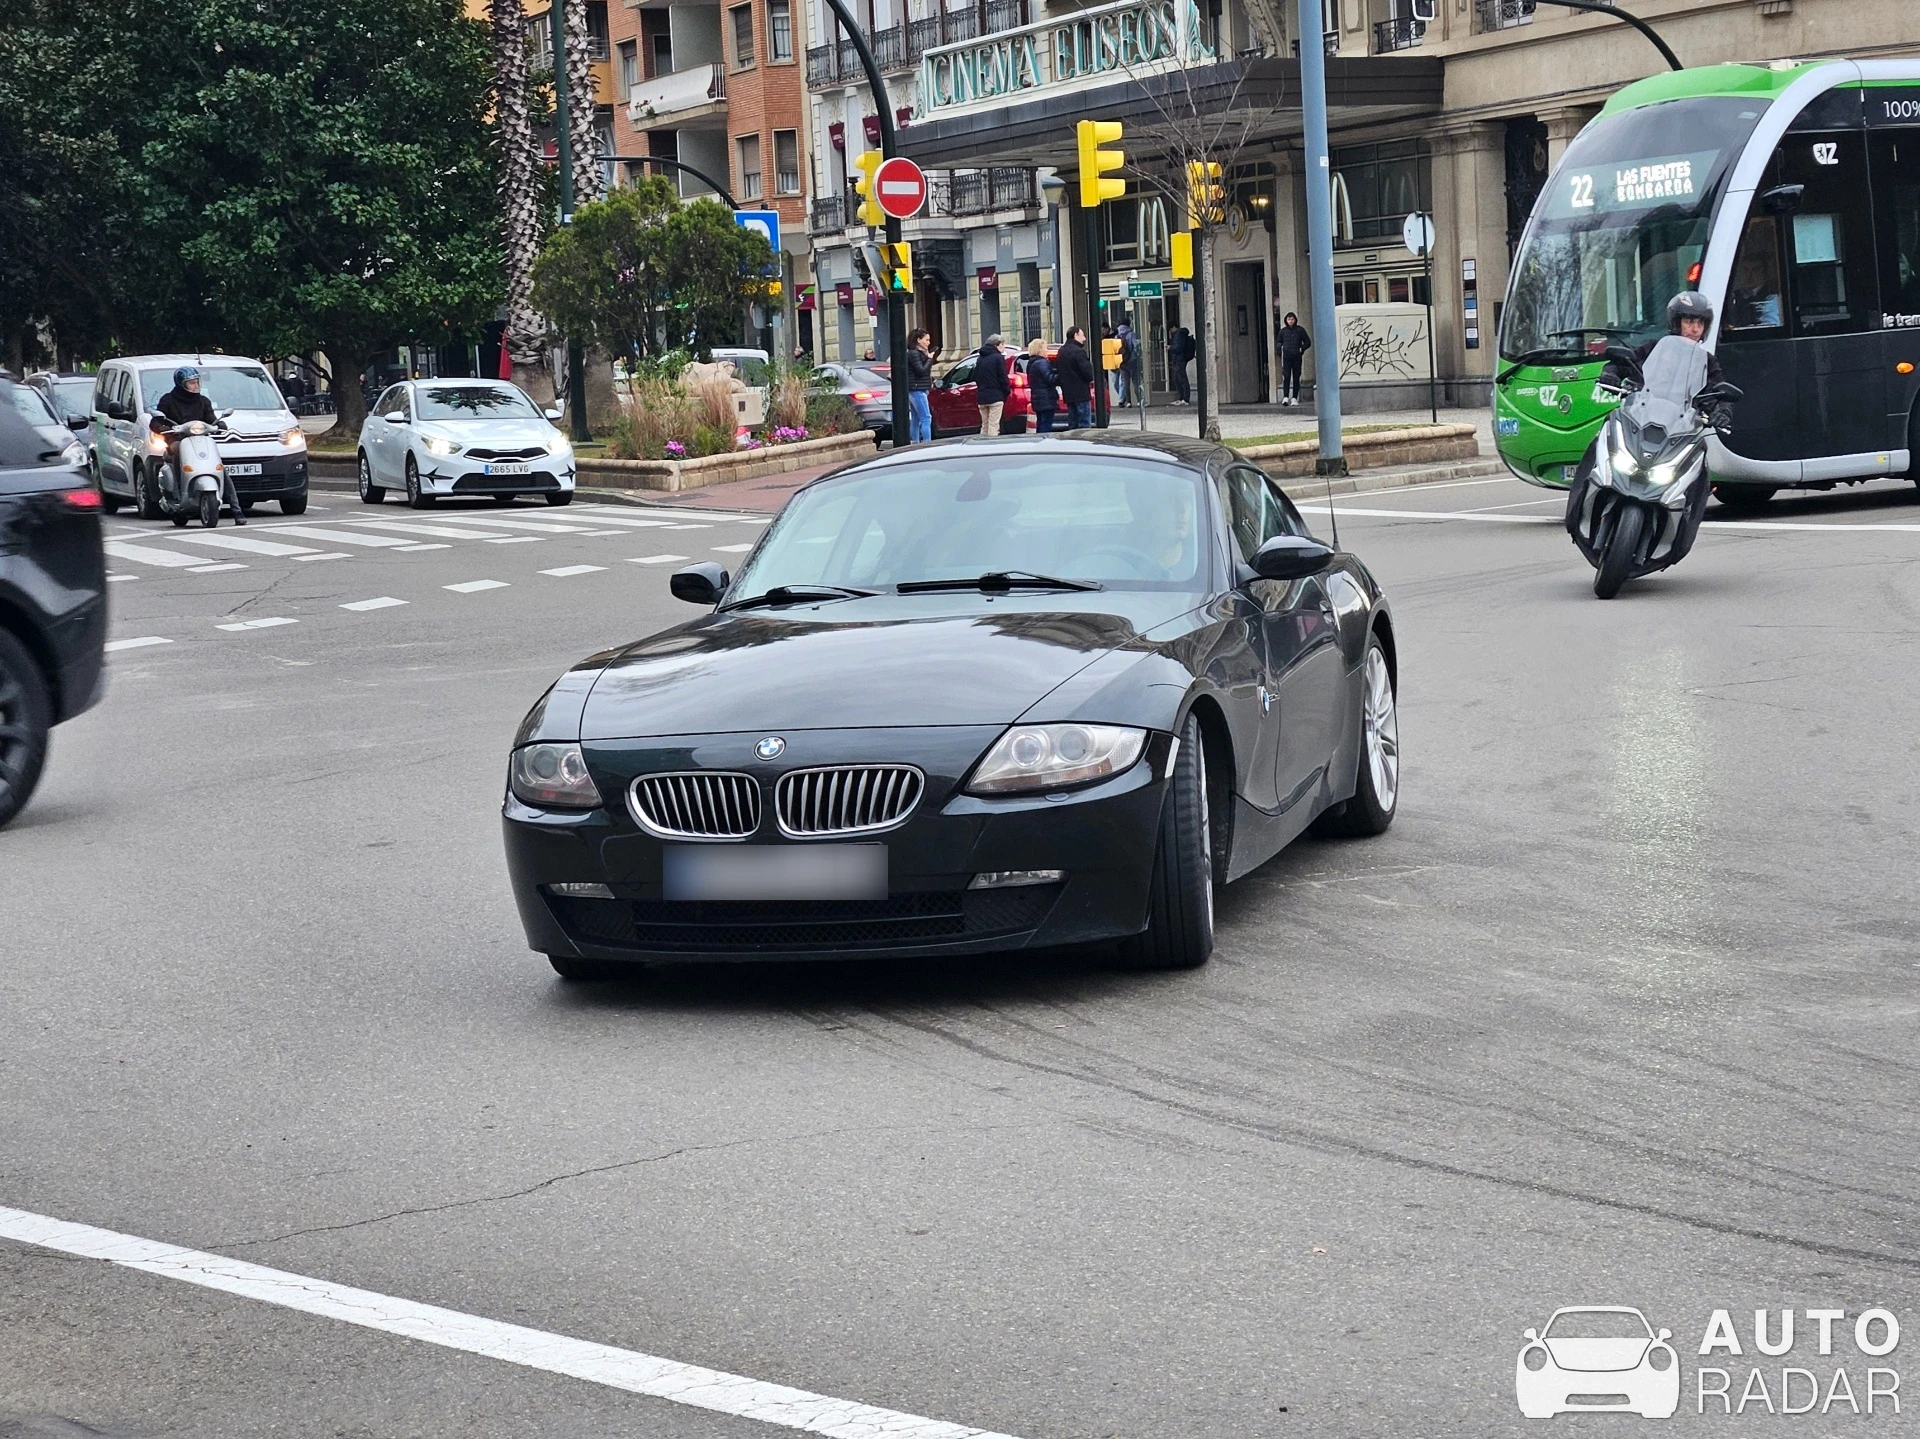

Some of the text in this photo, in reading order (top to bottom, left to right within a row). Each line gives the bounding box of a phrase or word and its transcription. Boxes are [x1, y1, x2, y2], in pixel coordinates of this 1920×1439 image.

[931, 35, 1043, 106] CINEMA
[1616, 160, 1691, 186] LAS FUENTES
[1571, 174, 1594, 208] 22
[1617, 177, 1693, 203] BOMBARDA
[224, 465, 240, 475] 961
[489, 464, 529, 474] 2665 LVG
